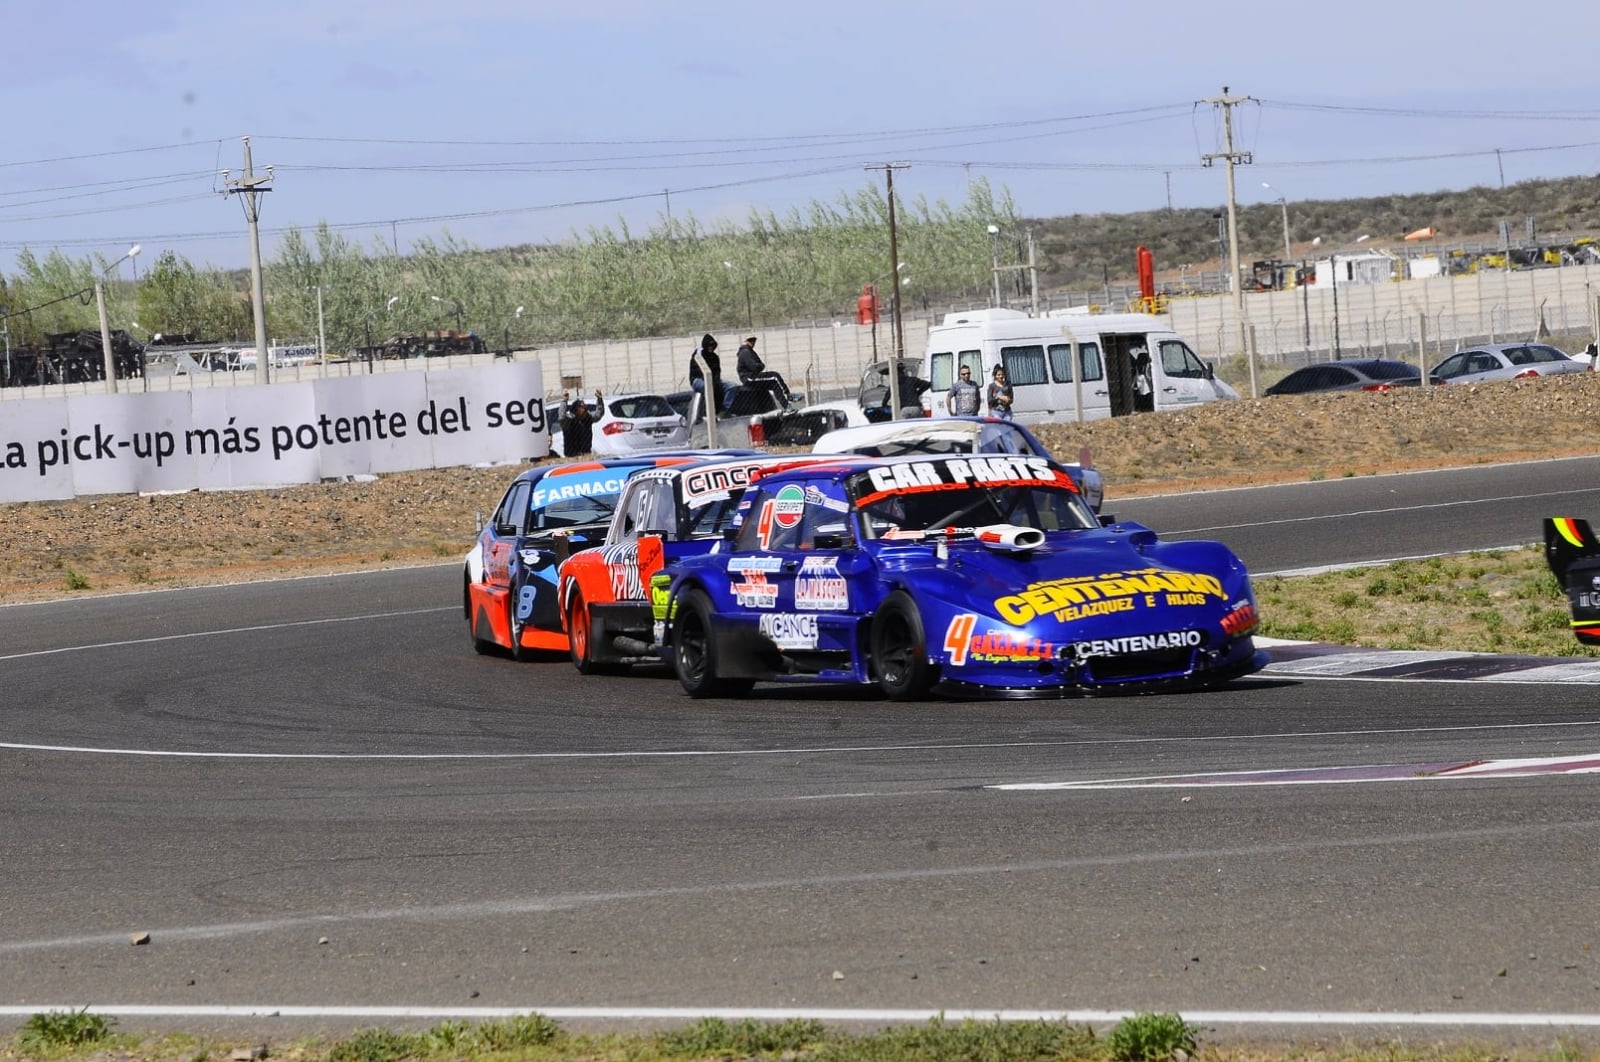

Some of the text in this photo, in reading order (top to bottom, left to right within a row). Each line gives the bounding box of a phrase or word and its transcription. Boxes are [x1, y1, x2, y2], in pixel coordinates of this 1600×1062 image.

[0, 396, 545, 477] a pick-up más potente del seg
[867, 458, 1057, 492] CAR PARTS
[757, 499, 776, 551] 4
[518, 585, 536, 619] 8
[994, 571, 1229, 626] CENTENARIO
[1054, 593, 1206, 623] VELAZQUEZ E HIJOS
[943, 613, 979, 667] 4
[1076, 631, 1201, 657] CENTENARIO
